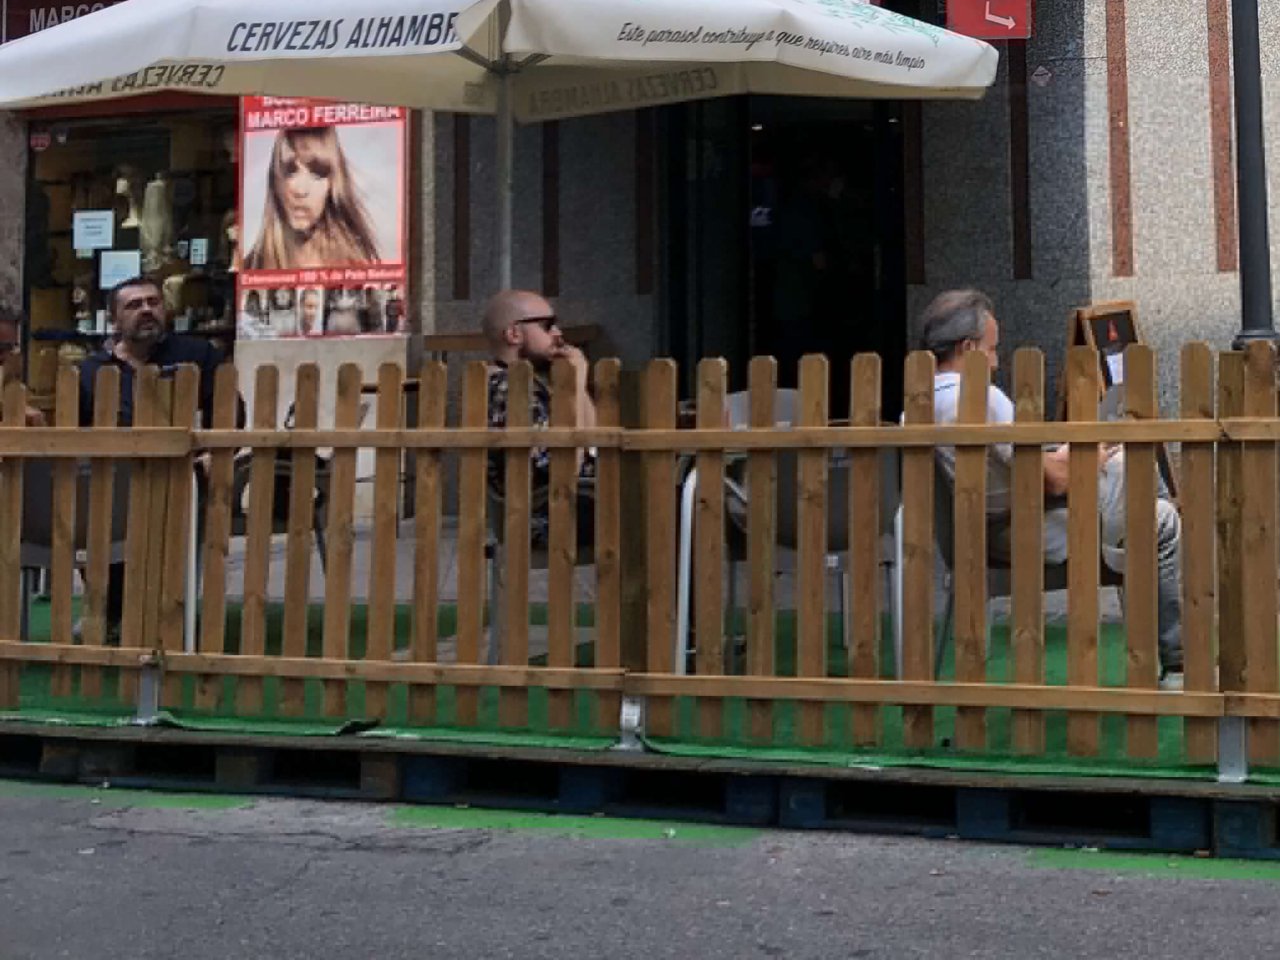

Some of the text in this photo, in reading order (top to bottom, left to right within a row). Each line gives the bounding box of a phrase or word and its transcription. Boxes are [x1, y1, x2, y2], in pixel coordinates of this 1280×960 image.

[226, 19, 344, 52] CERVEZAS
[617, 22, 645, 42] Este
[642, 25, 704, 47] parasol
[701, 26, 766, 51] contribuye
[776, 30, 804, 47] que
[804, 36, 850, 56] respires
[851, 46, 873, 61] aire
[873, 49, 894, 65] más
[894, 50, 926, 71] limpio
[248, 109, 308, 128] MARCO
